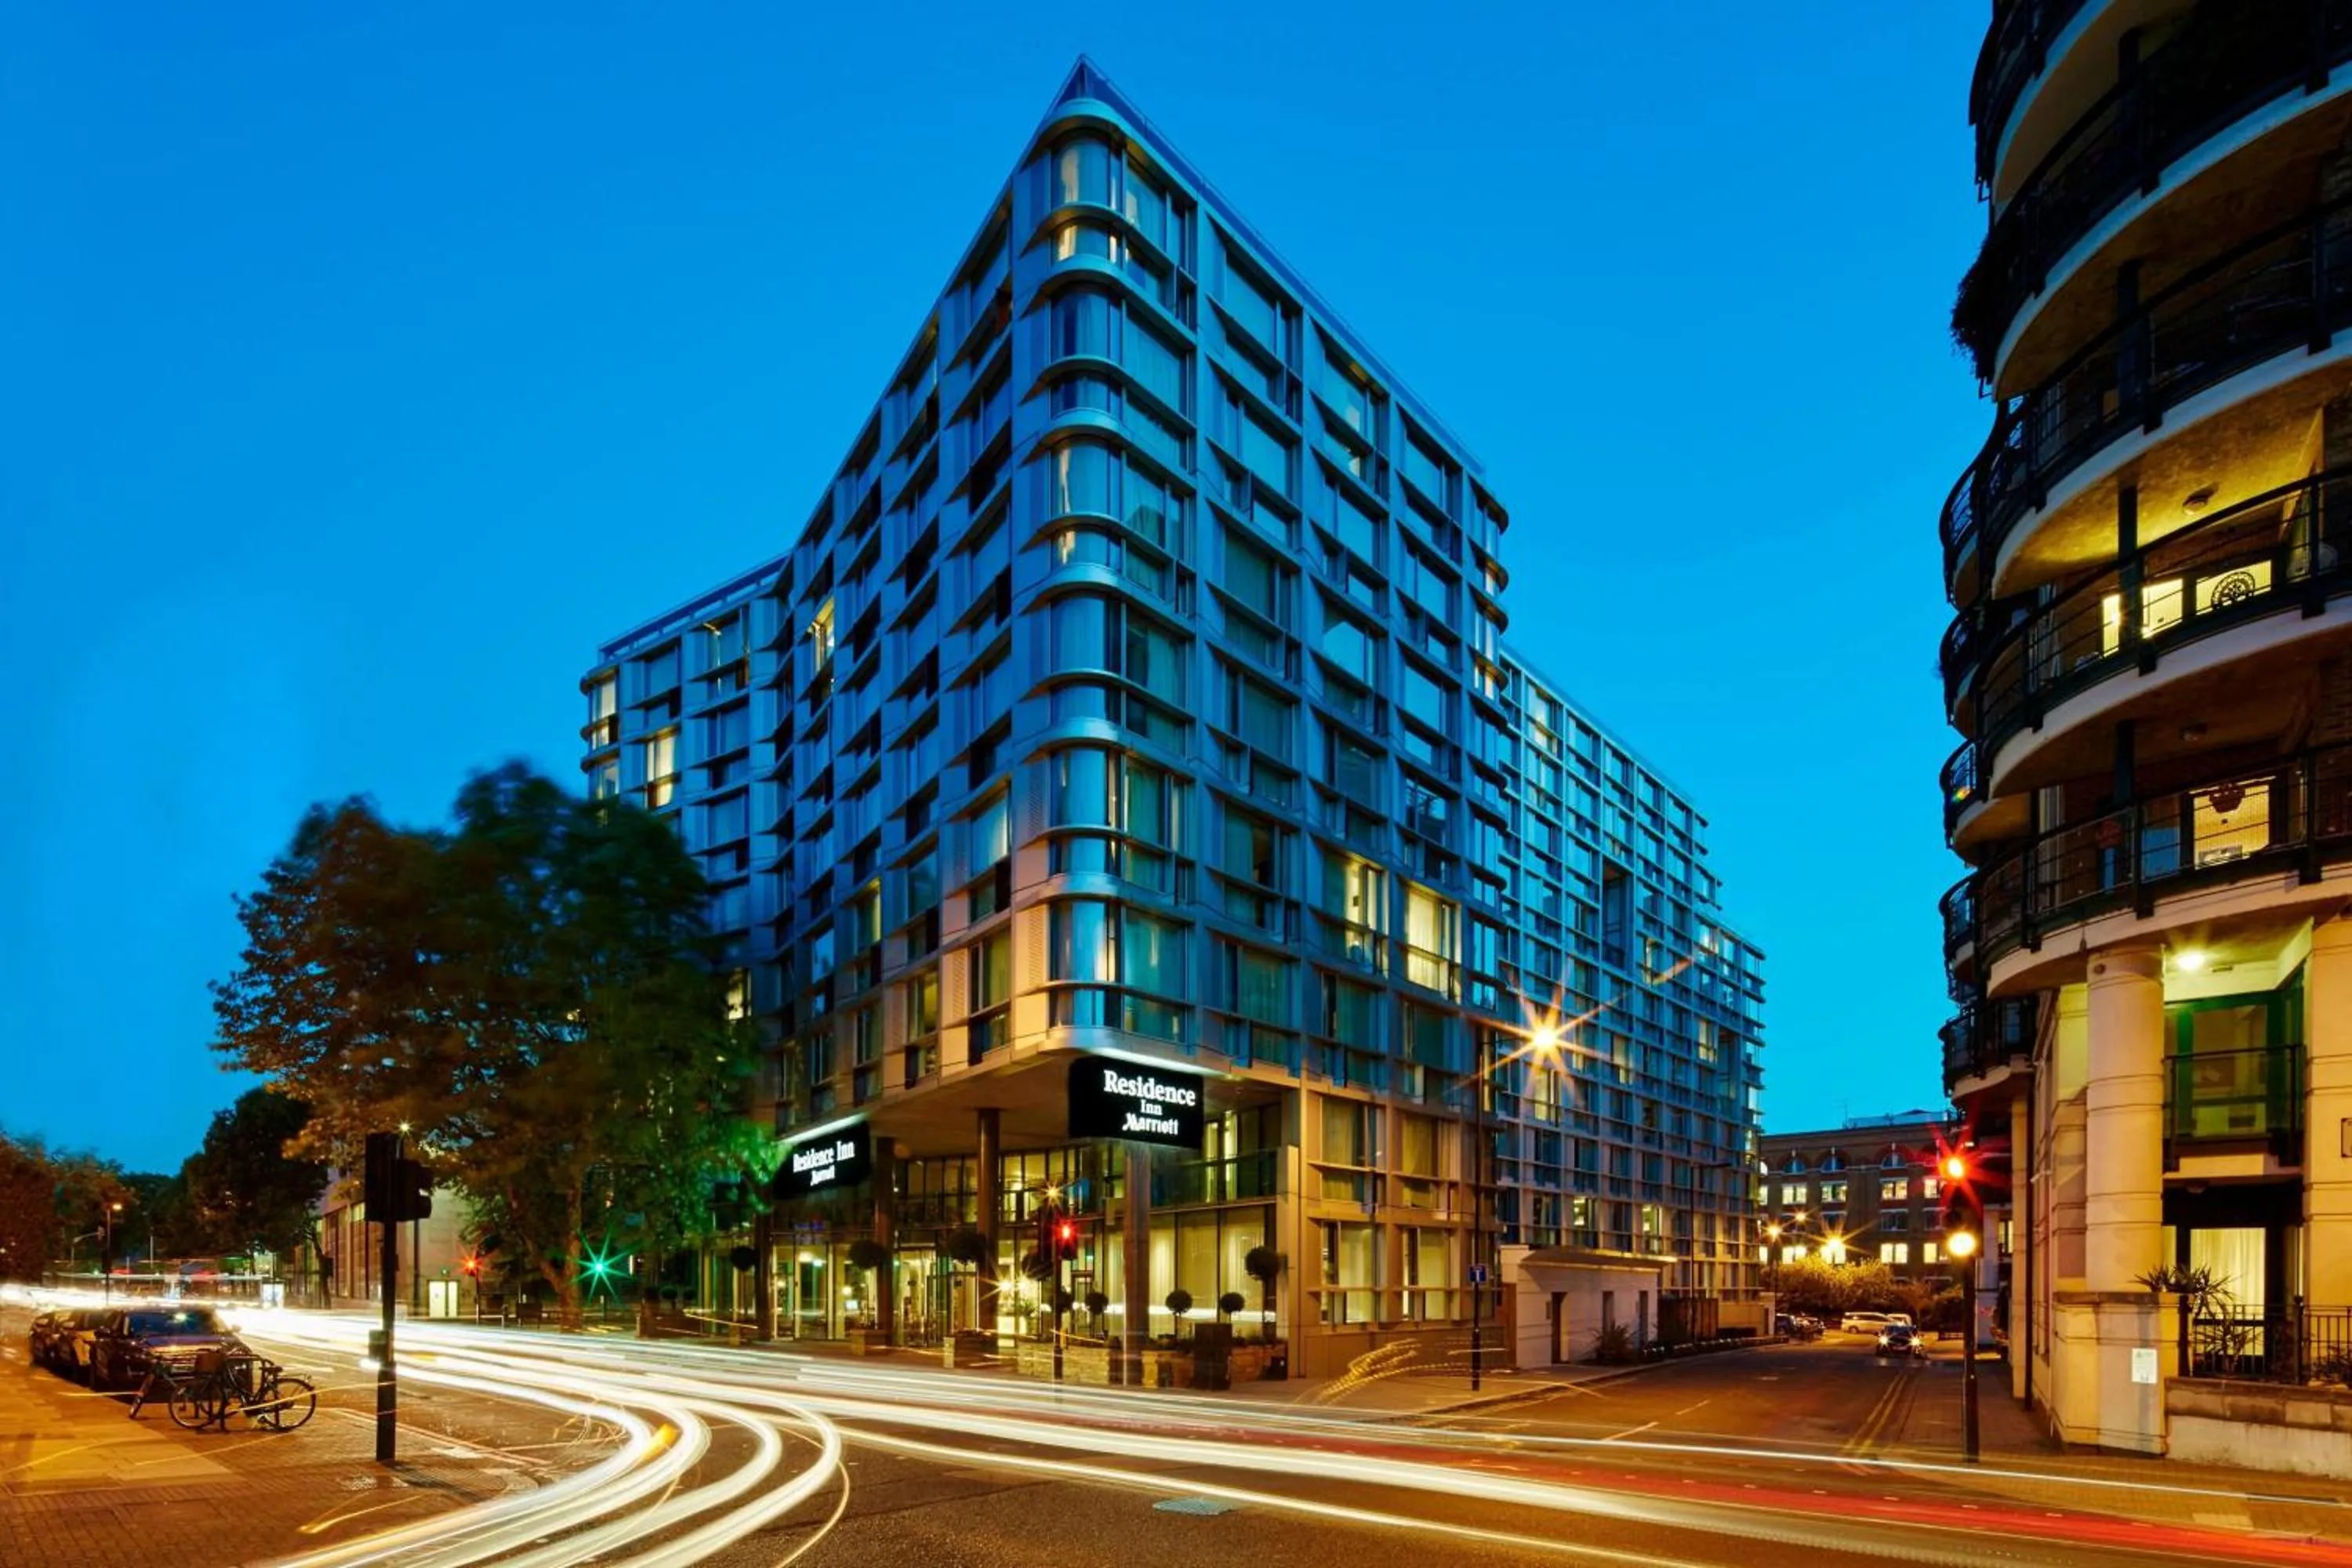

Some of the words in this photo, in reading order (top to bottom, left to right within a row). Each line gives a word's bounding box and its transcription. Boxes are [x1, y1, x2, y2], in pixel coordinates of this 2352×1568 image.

[1103, 1069, 1196, 1106] Residence
[1140, 1099, 1163, 1116] Inn
[1122, 1112, 1178, 1135] Marriott
[793, 1147, 835, 1173] Residence
[836, 1140, 855, 1161] Inn
